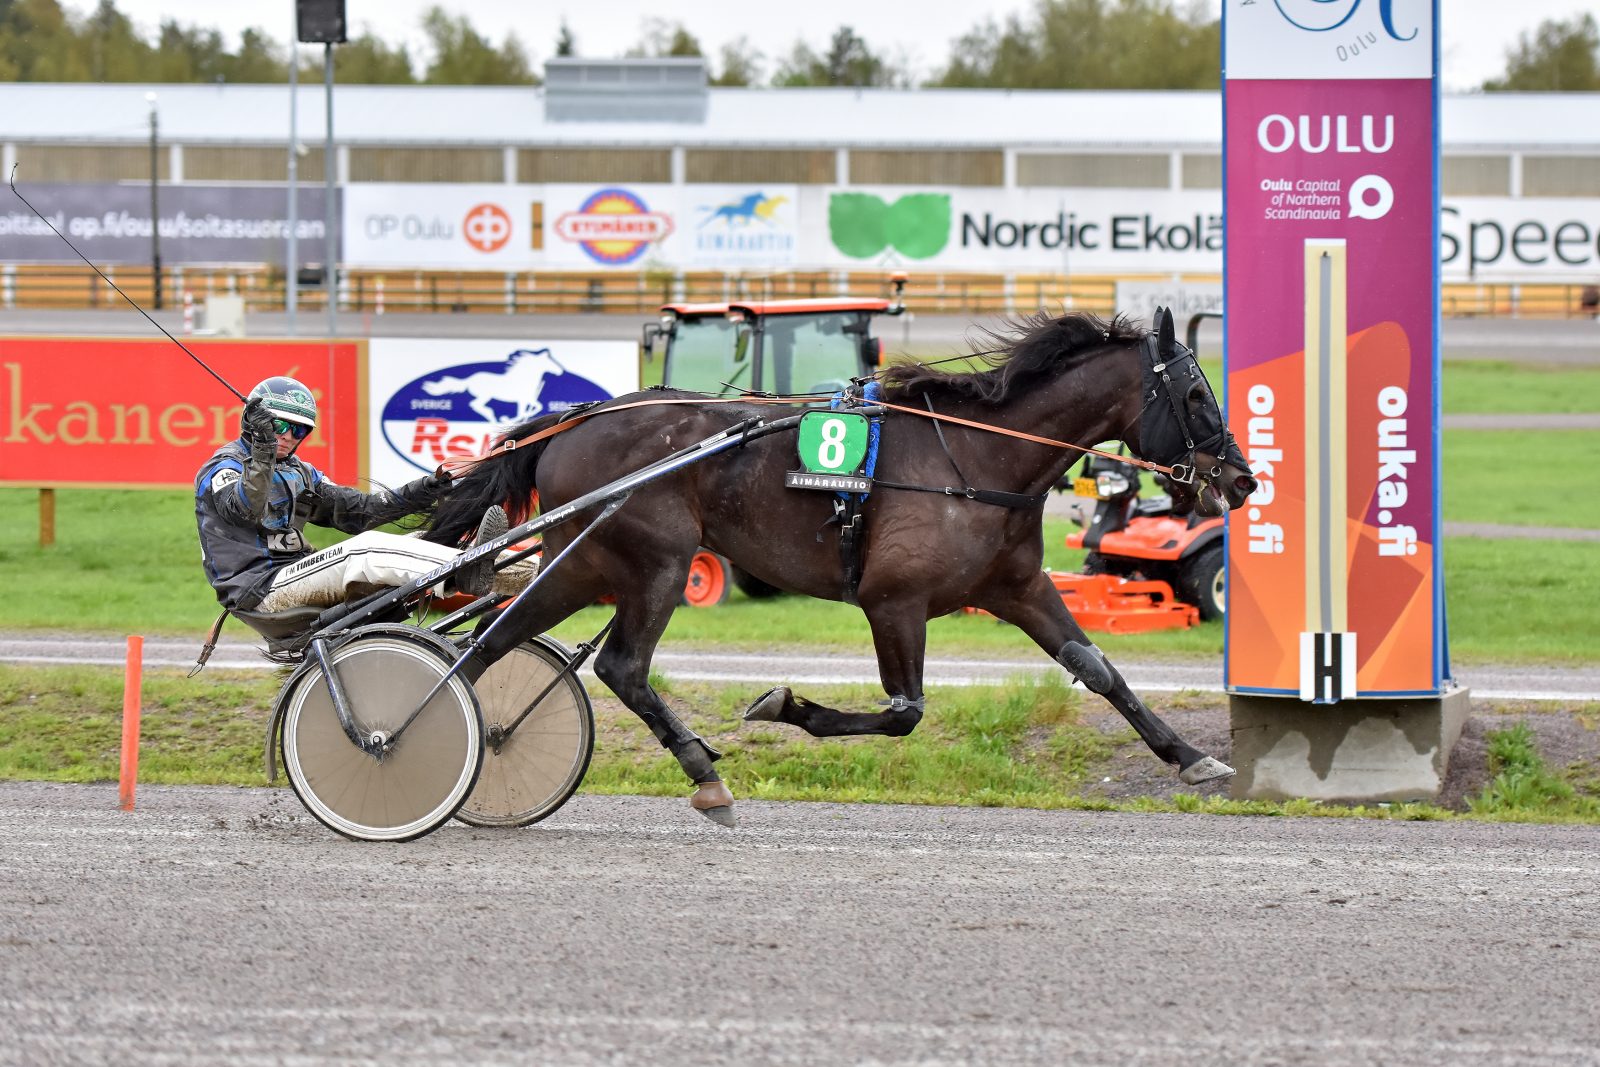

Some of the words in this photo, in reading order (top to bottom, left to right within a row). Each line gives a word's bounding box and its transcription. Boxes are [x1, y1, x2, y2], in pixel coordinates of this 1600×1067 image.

[1336, 31, 1377, 62] Oulu
[1257, 114, 1394, 153] OULU
[1260, 179, 1293, 192] Oulu
[1296, 179, 1341, 193] Capital
[1271, 193, 1285, 207] of
[1286, 194, 1341, 206] Northern
[364, 214, 400, 240] OP
[402, 213, 455, 240] Oulu
[961, 211, 1099, 249] Nordic
[1264, 207, 1341, 220] Scandinavia
[1441, 206, 1600, 278] Spee
[410, 399, 453, 411] SVERIGE
[818, 418, 847, 469] 8
[1248, 384, 1285, 554] ouka.fi
[1377, 386, 1417, 556] ouka.fi
